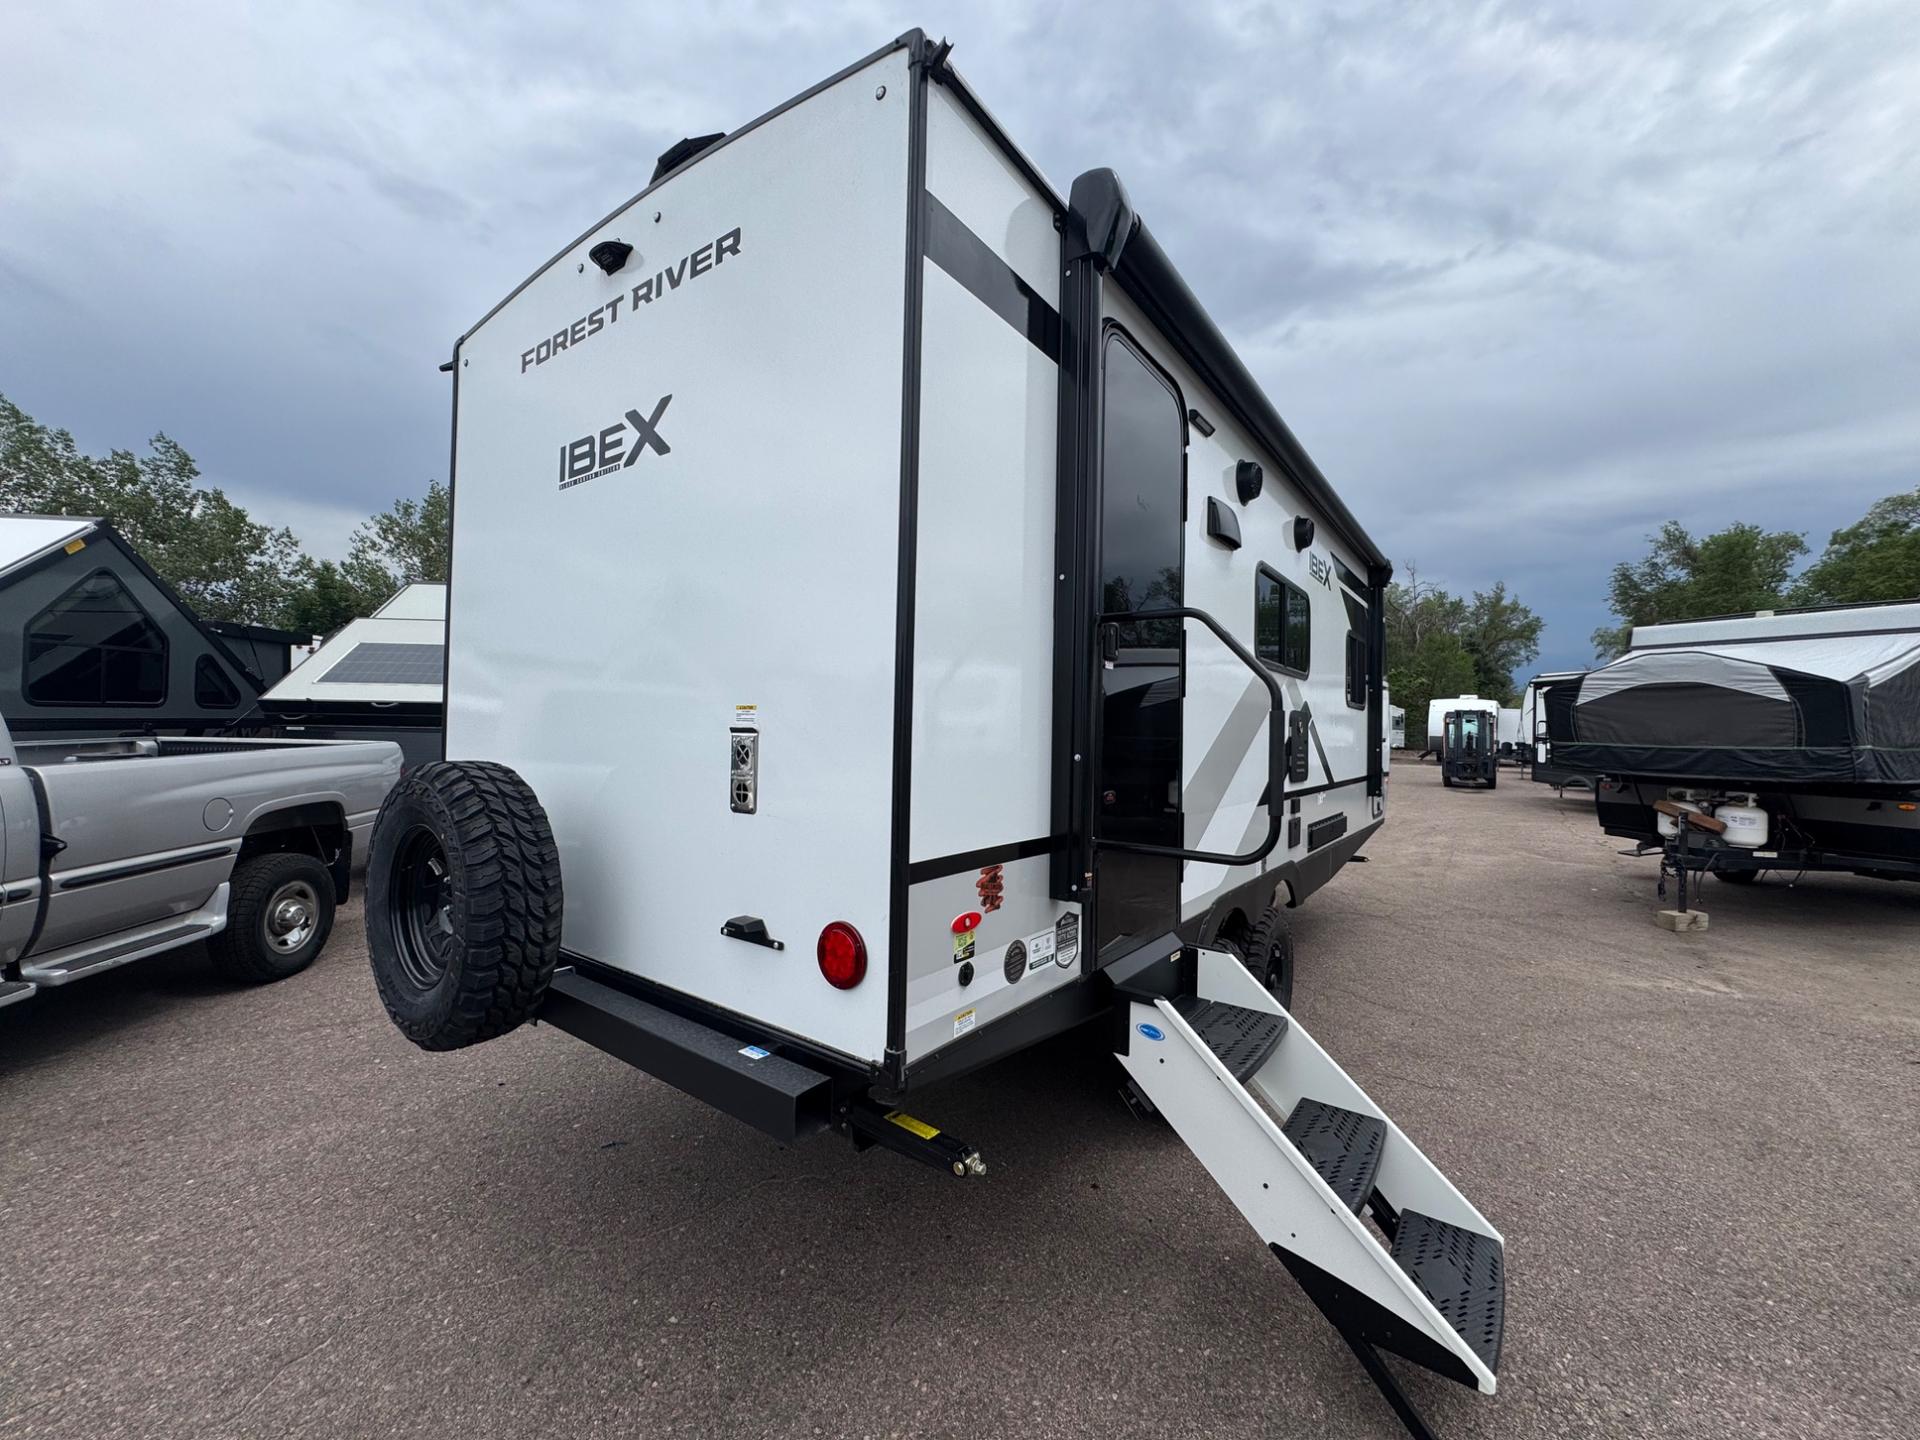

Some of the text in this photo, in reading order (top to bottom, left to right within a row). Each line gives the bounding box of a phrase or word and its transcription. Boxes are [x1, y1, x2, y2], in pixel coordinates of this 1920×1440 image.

[521, 227, 742, 374] FOREST RIVER
[559, 393, 673, 483] IBEX
[1308, 551, 1332, 591] IBEX
